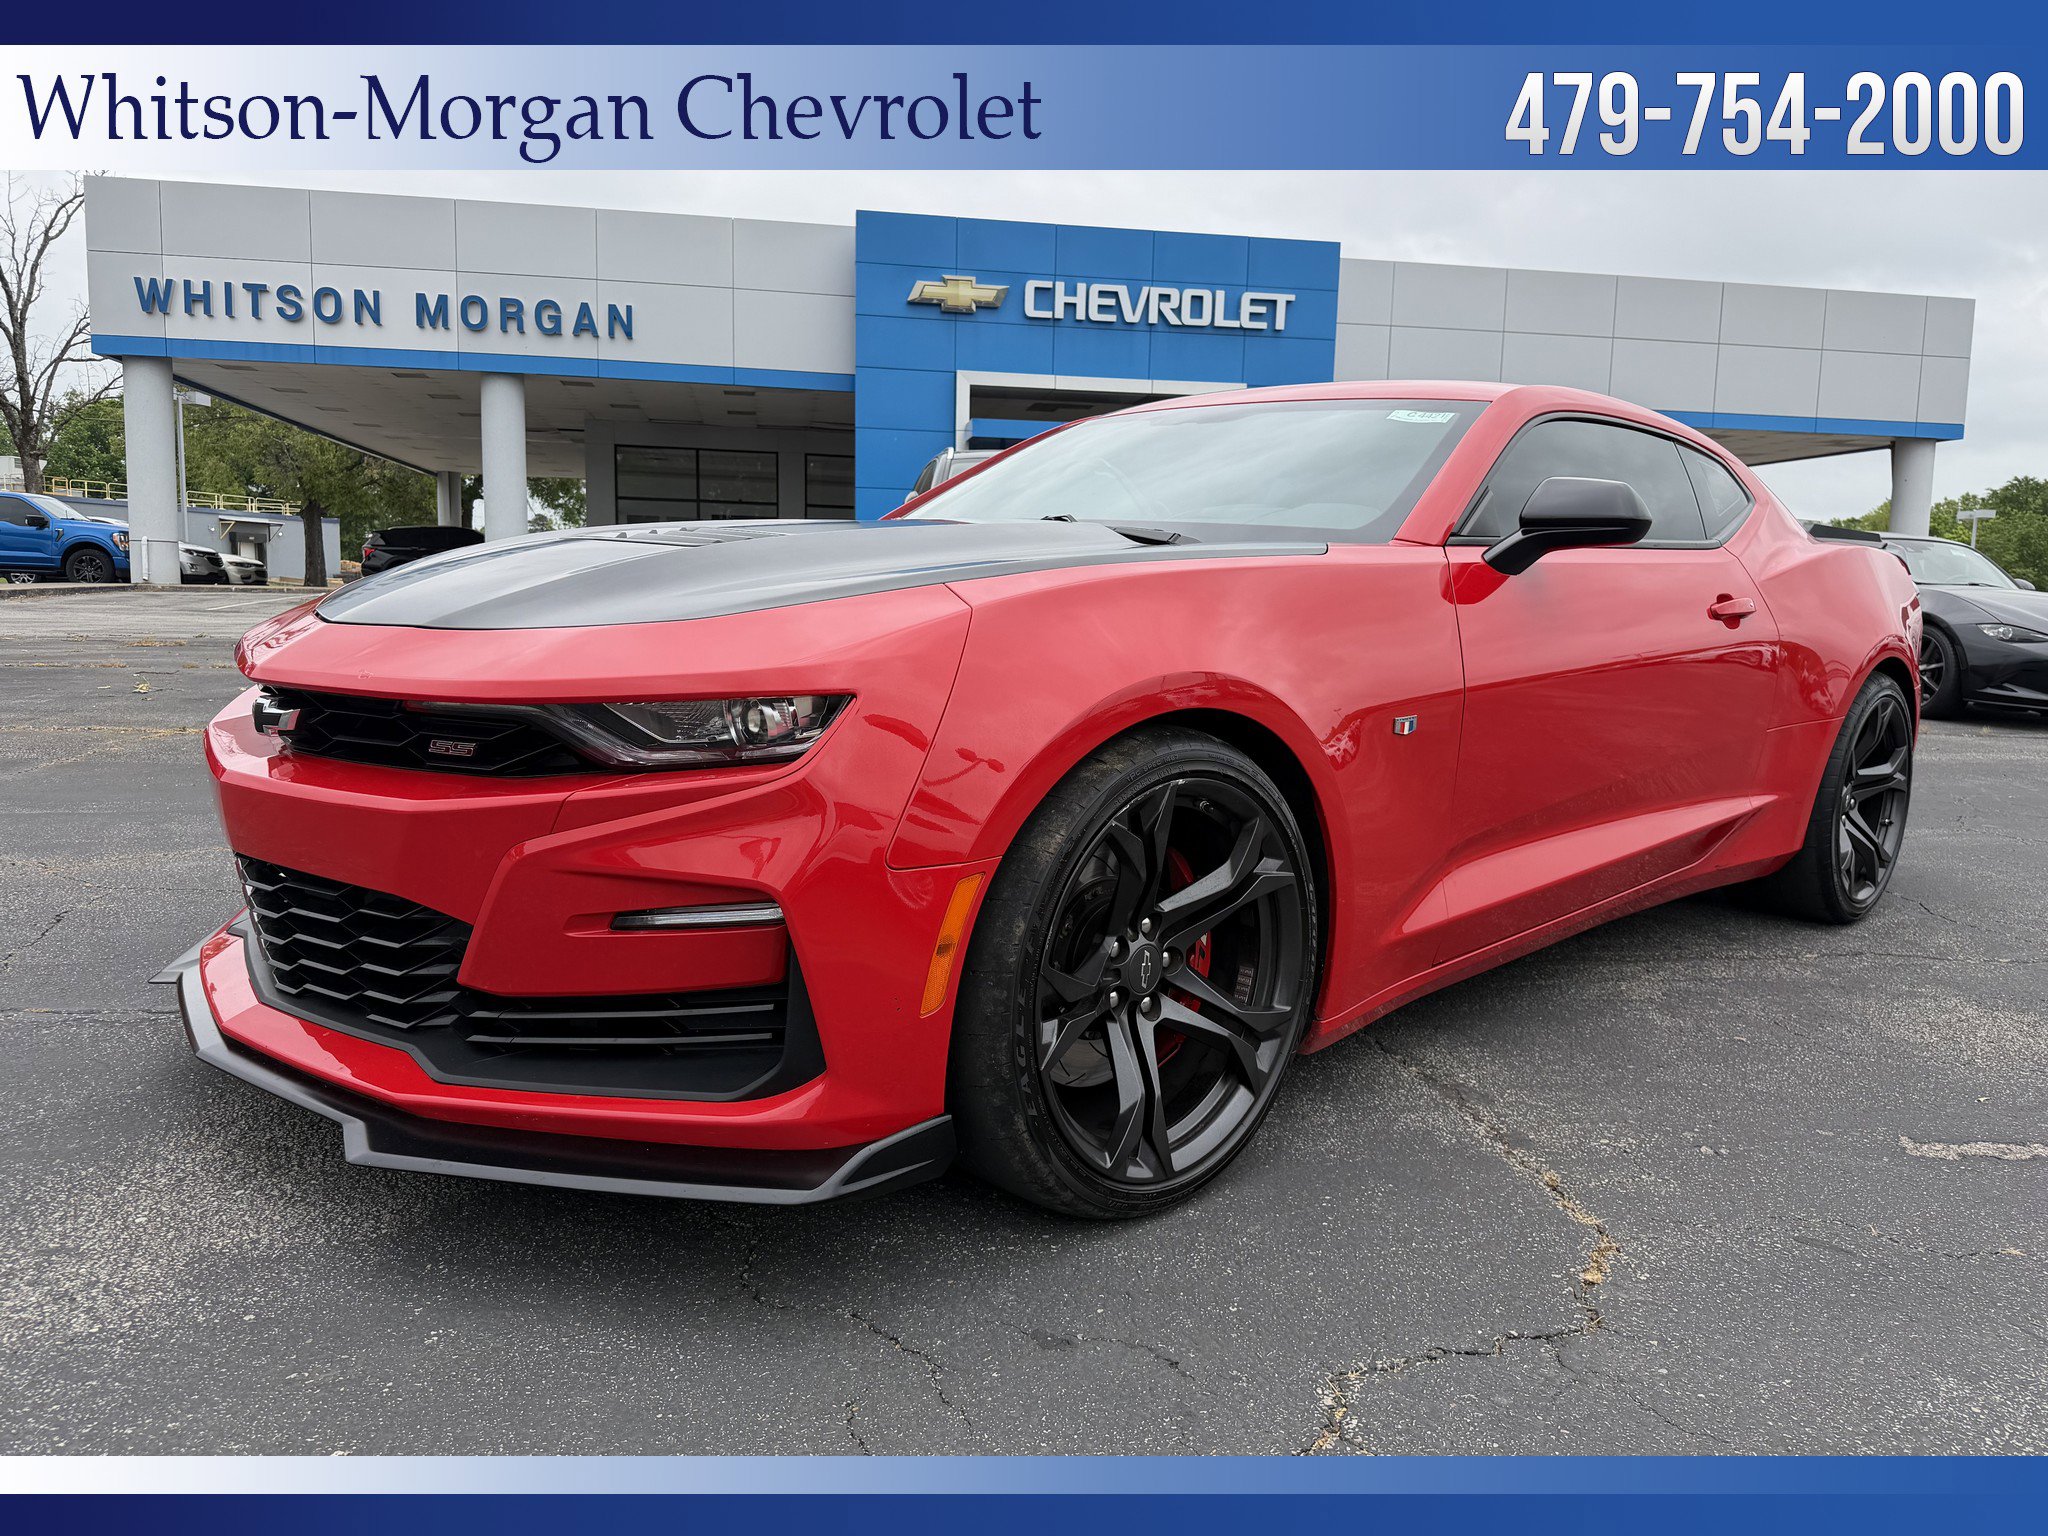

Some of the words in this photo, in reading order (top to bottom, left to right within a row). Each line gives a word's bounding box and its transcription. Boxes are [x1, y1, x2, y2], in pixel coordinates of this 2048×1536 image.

[133, 276, 382, 326] WHITSON
[415, 292, 634, 339] MORGAN
[1024, 279, 1296, 330] CHEVROLET
[428, 739, 476, 757] SS
